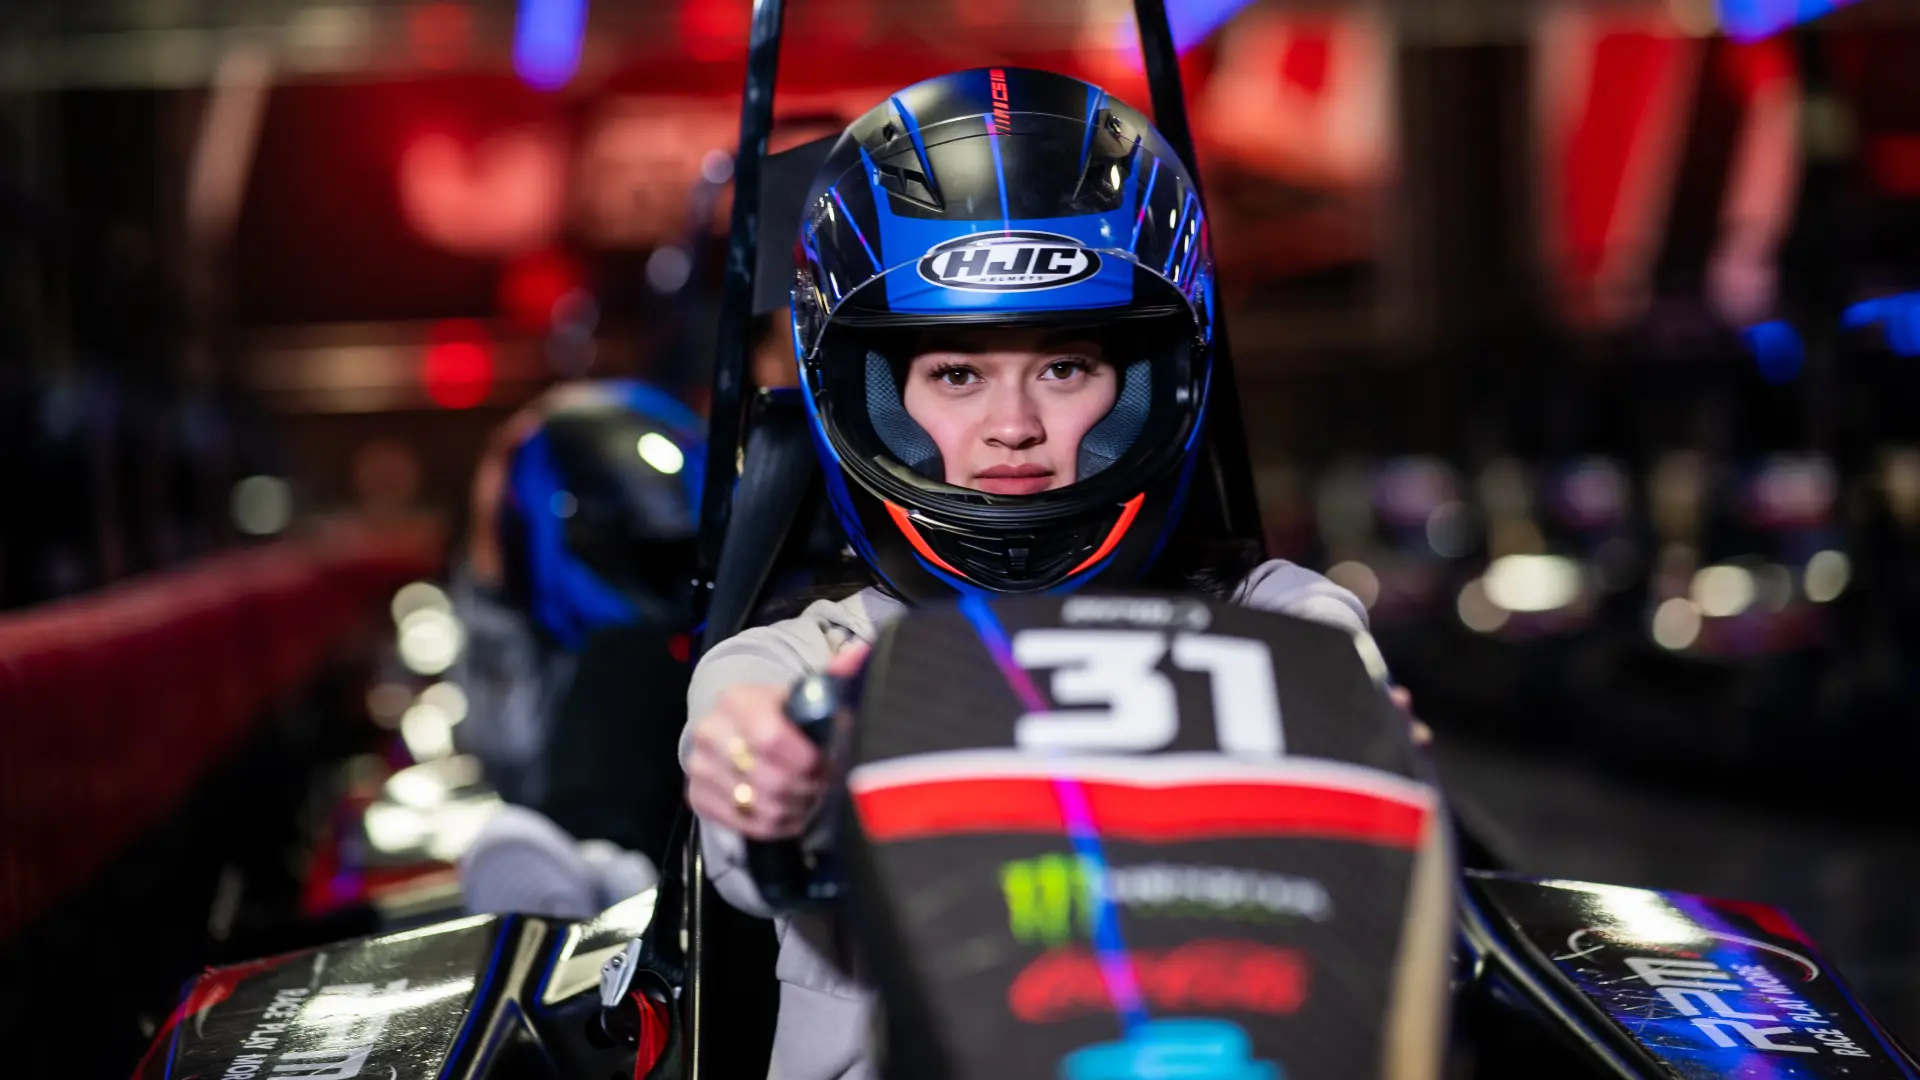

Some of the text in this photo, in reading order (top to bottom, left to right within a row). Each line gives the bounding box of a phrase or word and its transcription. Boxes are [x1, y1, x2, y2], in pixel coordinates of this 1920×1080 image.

[943, 248, 1077, 278] HJC
[1013, 629, 1285, 758] 31
[263, 988, 309, 1019] RACE
[1624, 957, 1819, 1053] RPM
[1767, 997, 1830, 1023] PLAY
[243, 1023, 287, 1049] PLAY
[1804, 1027, 1871, 1057] RACE
